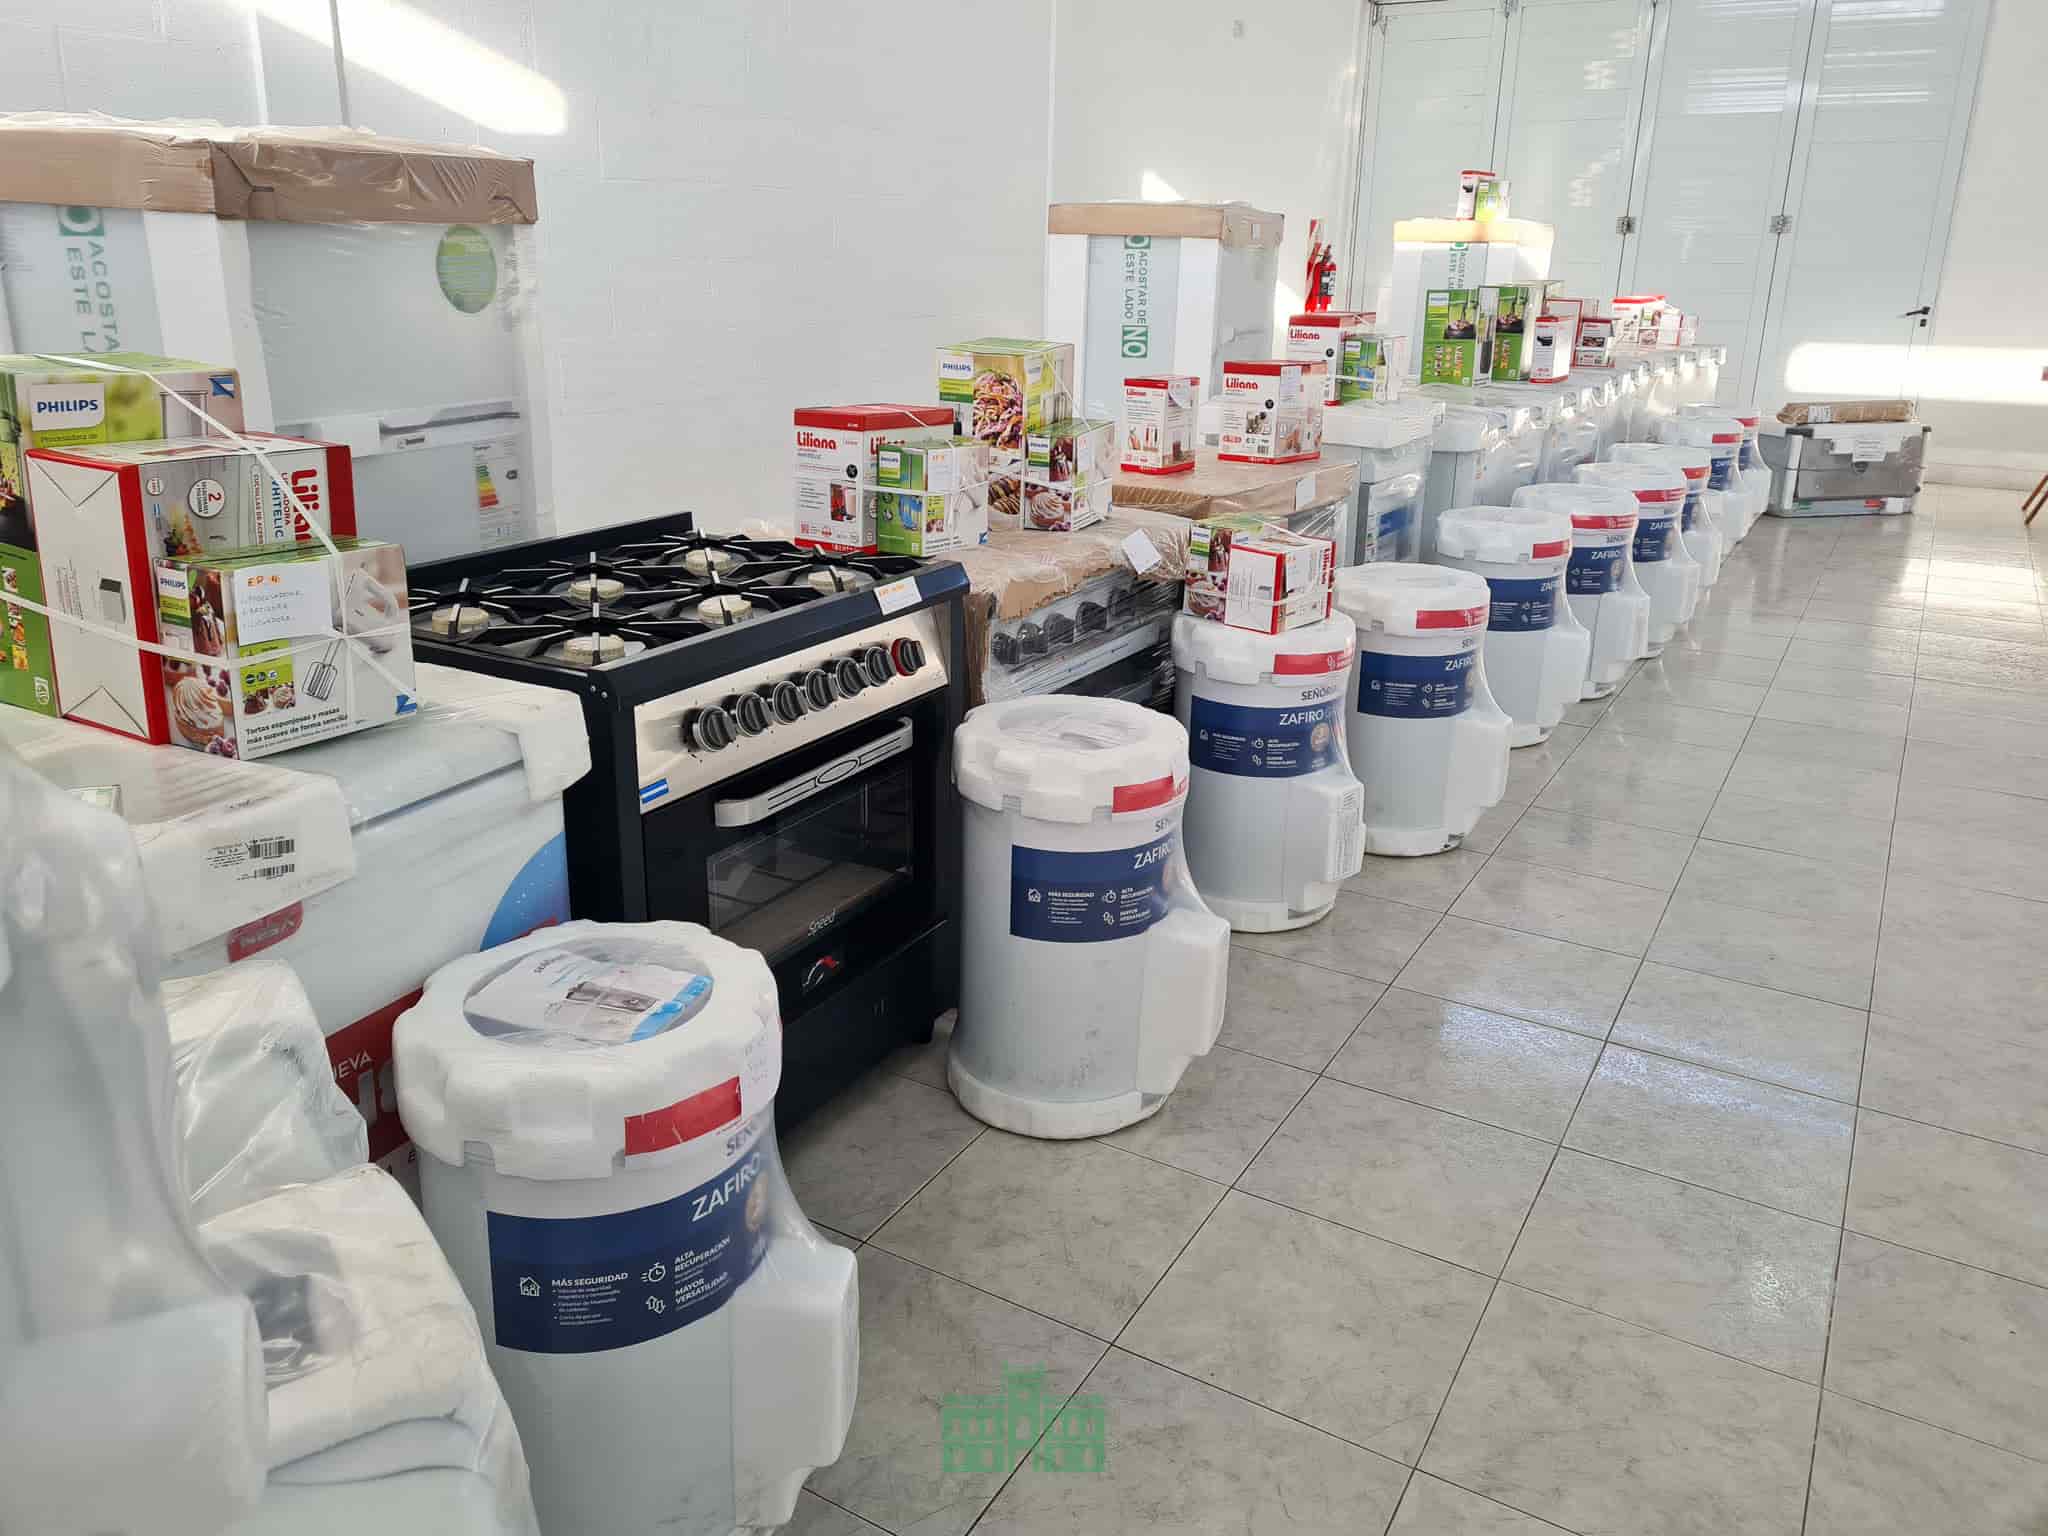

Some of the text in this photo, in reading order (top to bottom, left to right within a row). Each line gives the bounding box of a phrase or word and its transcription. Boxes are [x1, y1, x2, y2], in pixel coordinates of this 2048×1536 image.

[66, 247, 92, 313] ESTE
[1124, 252, 1135, 319] ESTE LADO
[1137, 250, 1148, 324] ACOSTAR DE
[1122, 326, 1148, 357] NO
[1289, 328, 1320, 340] Liliana
[942, 362, 971, 372] PHILIPS
[1225, 378, 1258, 390] Liliana
[37, 399, 99, 413] PHILIPS
[797, 431, 837, 450] Liliana
[208, 491, 222, 502] 2
[1279, 709, 1324, 726] ZAFIRO
[691, 1151, 761, 1222] ZAFIRO
[674, 1249, 695, 1264] ALTA
[574, 1272, 629, 1286] SEGURIDAD
[674, 1278, 705, 1298] MAYOR
